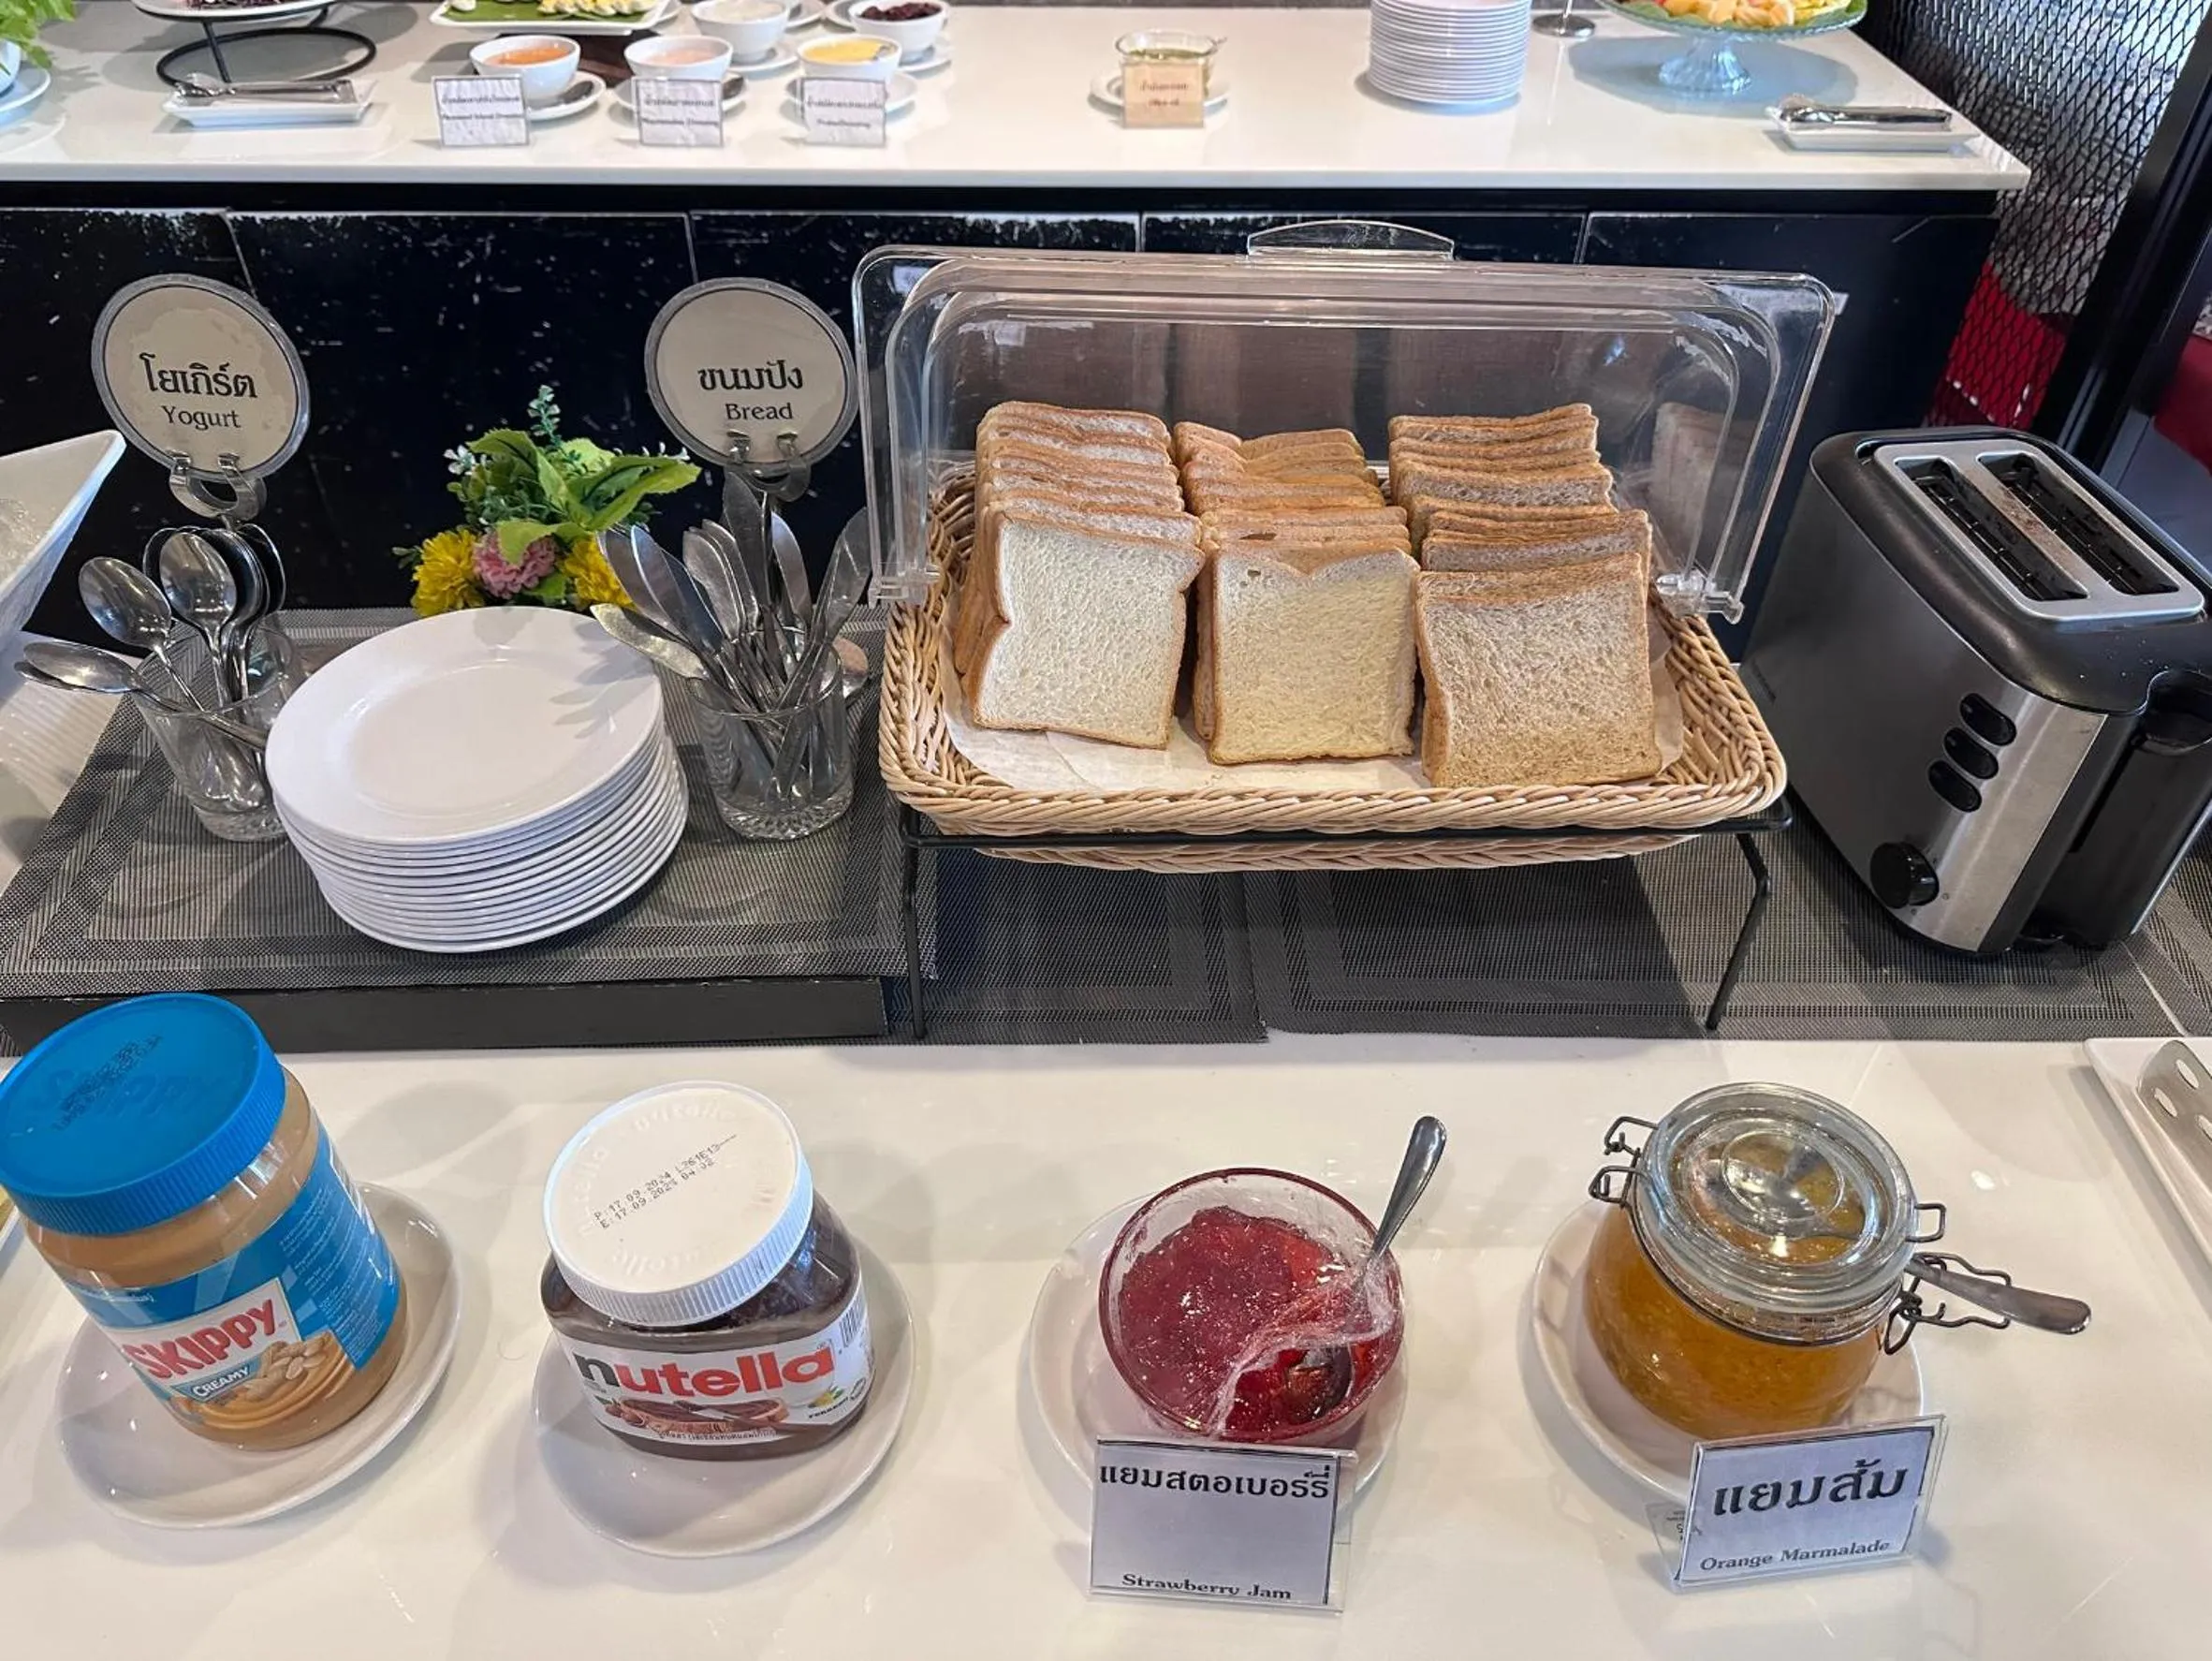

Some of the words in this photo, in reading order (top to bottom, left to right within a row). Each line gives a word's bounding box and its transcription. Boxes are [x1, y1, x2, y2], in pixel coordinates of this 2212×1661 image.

[139, 352, 258, 399] โยเกิร์ต
[697, 359, 803, 390] ขนมปัง
[160, 404, 242, 432] Yogurt
[725, 402, 795, 420] Bread
[122, 1299, 275, 1379] SKIPPY
[192, 1366, 259, 1398] CREAMY
[573, 1345, 835, 1397] nutella
[1099, 1464, 1331, 1499] แยมสตอเบอร์รี่
[1713, 1458, 1909, 1516] แยมส้ม
[1699, 1553, 1773, 1571] Orange
[1780, 1539, 1890, 1563] Marmalade
[1121, 1573, 1240, 1596] Strawberry
[1246, 1583, 1293, 1600] Jam
